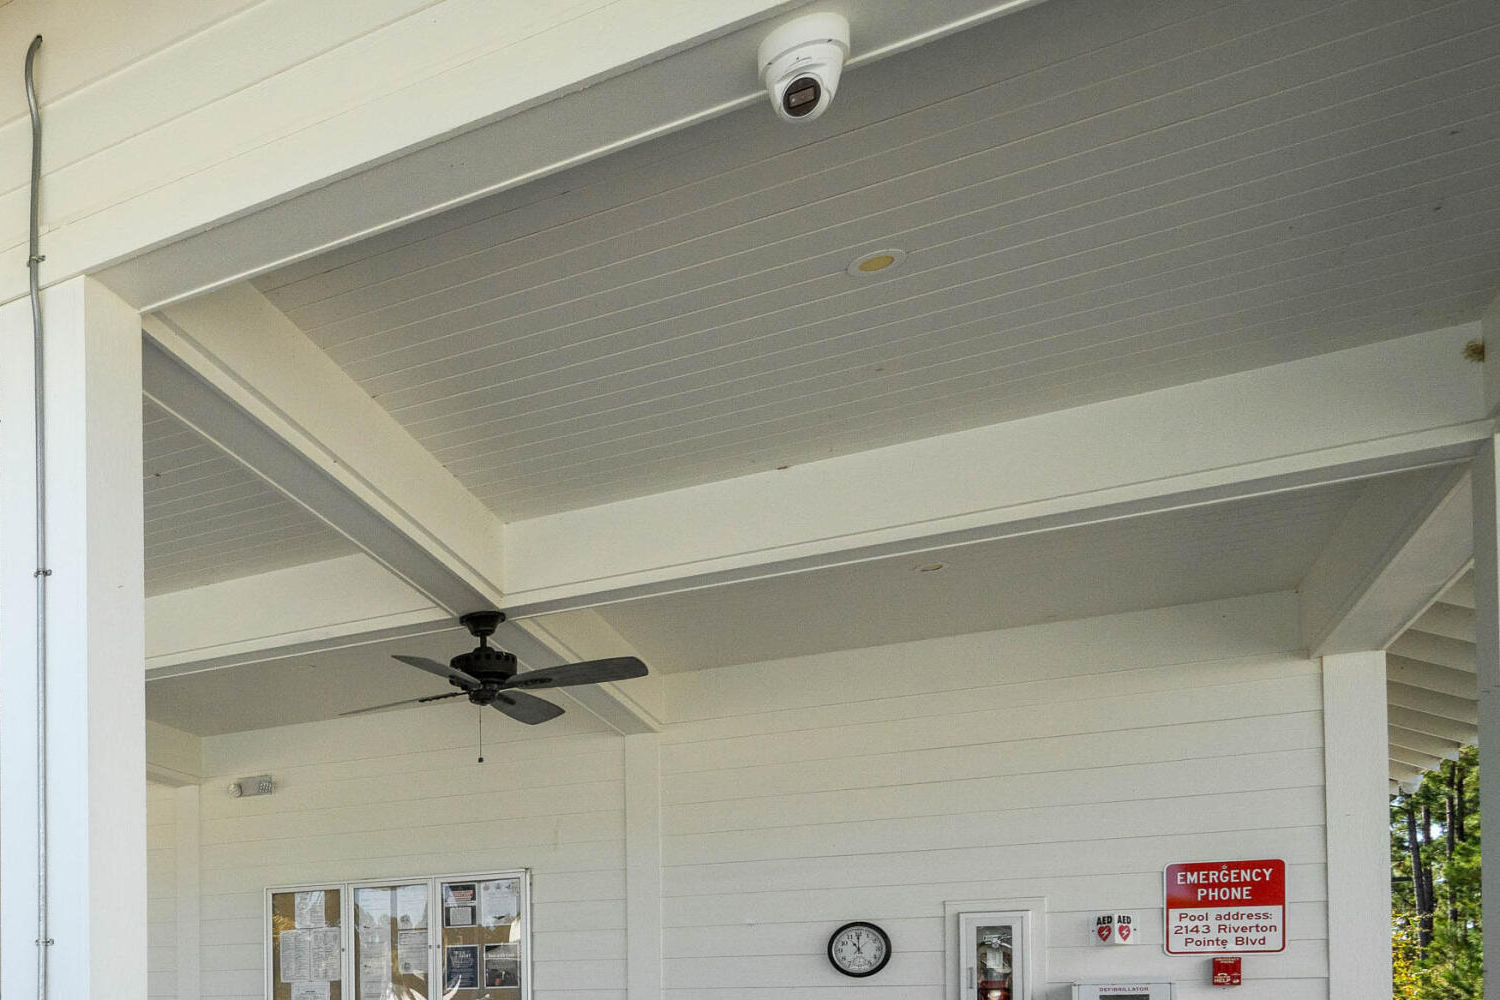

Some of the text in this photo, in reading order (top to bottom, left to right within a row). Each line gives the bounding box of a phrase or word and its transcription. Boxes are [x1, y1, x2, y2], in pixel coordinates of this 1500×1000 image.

[1177, 868, 1273, 885] EMERGENCY
[1197, 886, 1252, 901] PHONE
[1096, 915, 1113, 926] AED
[1117, 914, 1132, 925] AED
[1178, 911, 1273, 922] Pool address:
[1174, 923, 1277, 934] 2143 Riverton
[1184, 936, 1266, 947] Pointe Blvd
